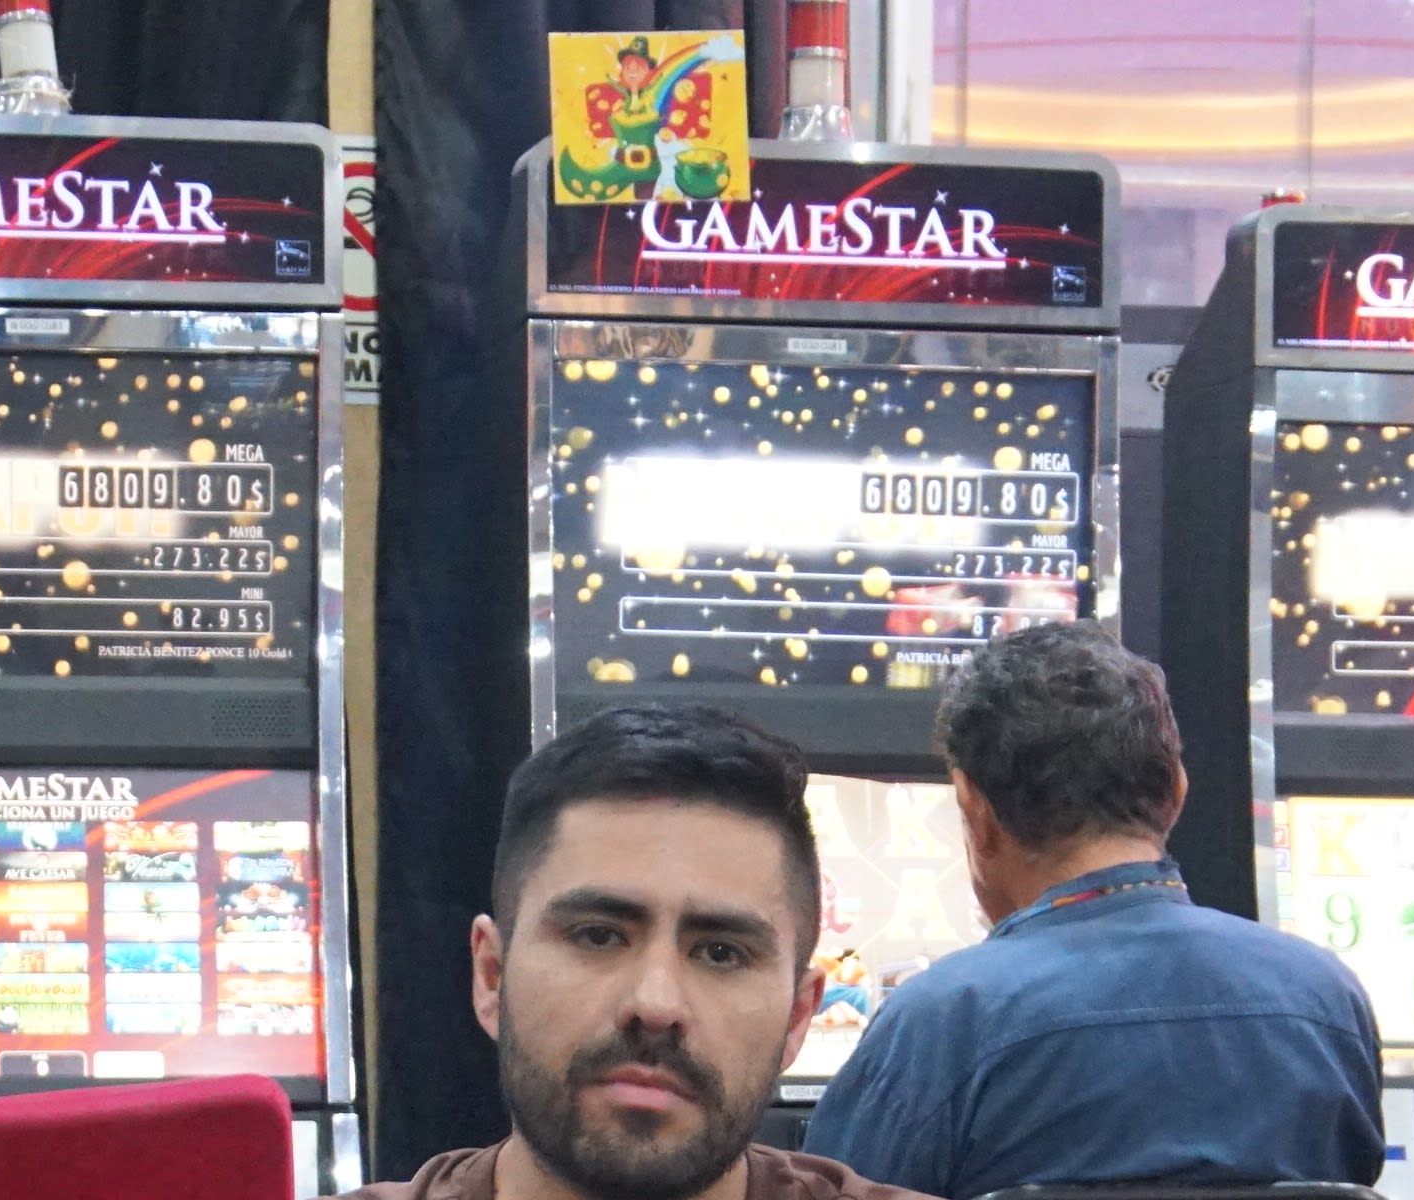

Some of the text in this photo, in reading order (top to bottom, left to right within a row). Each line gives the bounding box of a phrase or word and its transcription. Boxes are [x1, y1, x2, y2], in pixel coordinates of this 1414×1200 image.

[225, 444, 265, 462] MEGA
[1030, 453, 1071, 472] MEGA
[63, 471, 264, 503] 6809.80$
[864, 477, 1070, 515] 6809.80$
[228, 526, 264, 540] MAYOR
[1032, 535, 1068, 549] MAYOR
[241, 587, 264, 601] MINI
[172, 606, 264, 630] 82.95$
[97, 644, 152, 658] PATRICIA
[153, 646, 202, 658] BENITEZ
[204, 646, 245, 658] PONCE
[895, 651, 951, 665] PATRICIA
[51, 805, 78, 821] UN
[79, 806, 136, 823] JUEGO
[4, 868, 27, 880] AVE
[1324, 891, 1363, 952] 9
